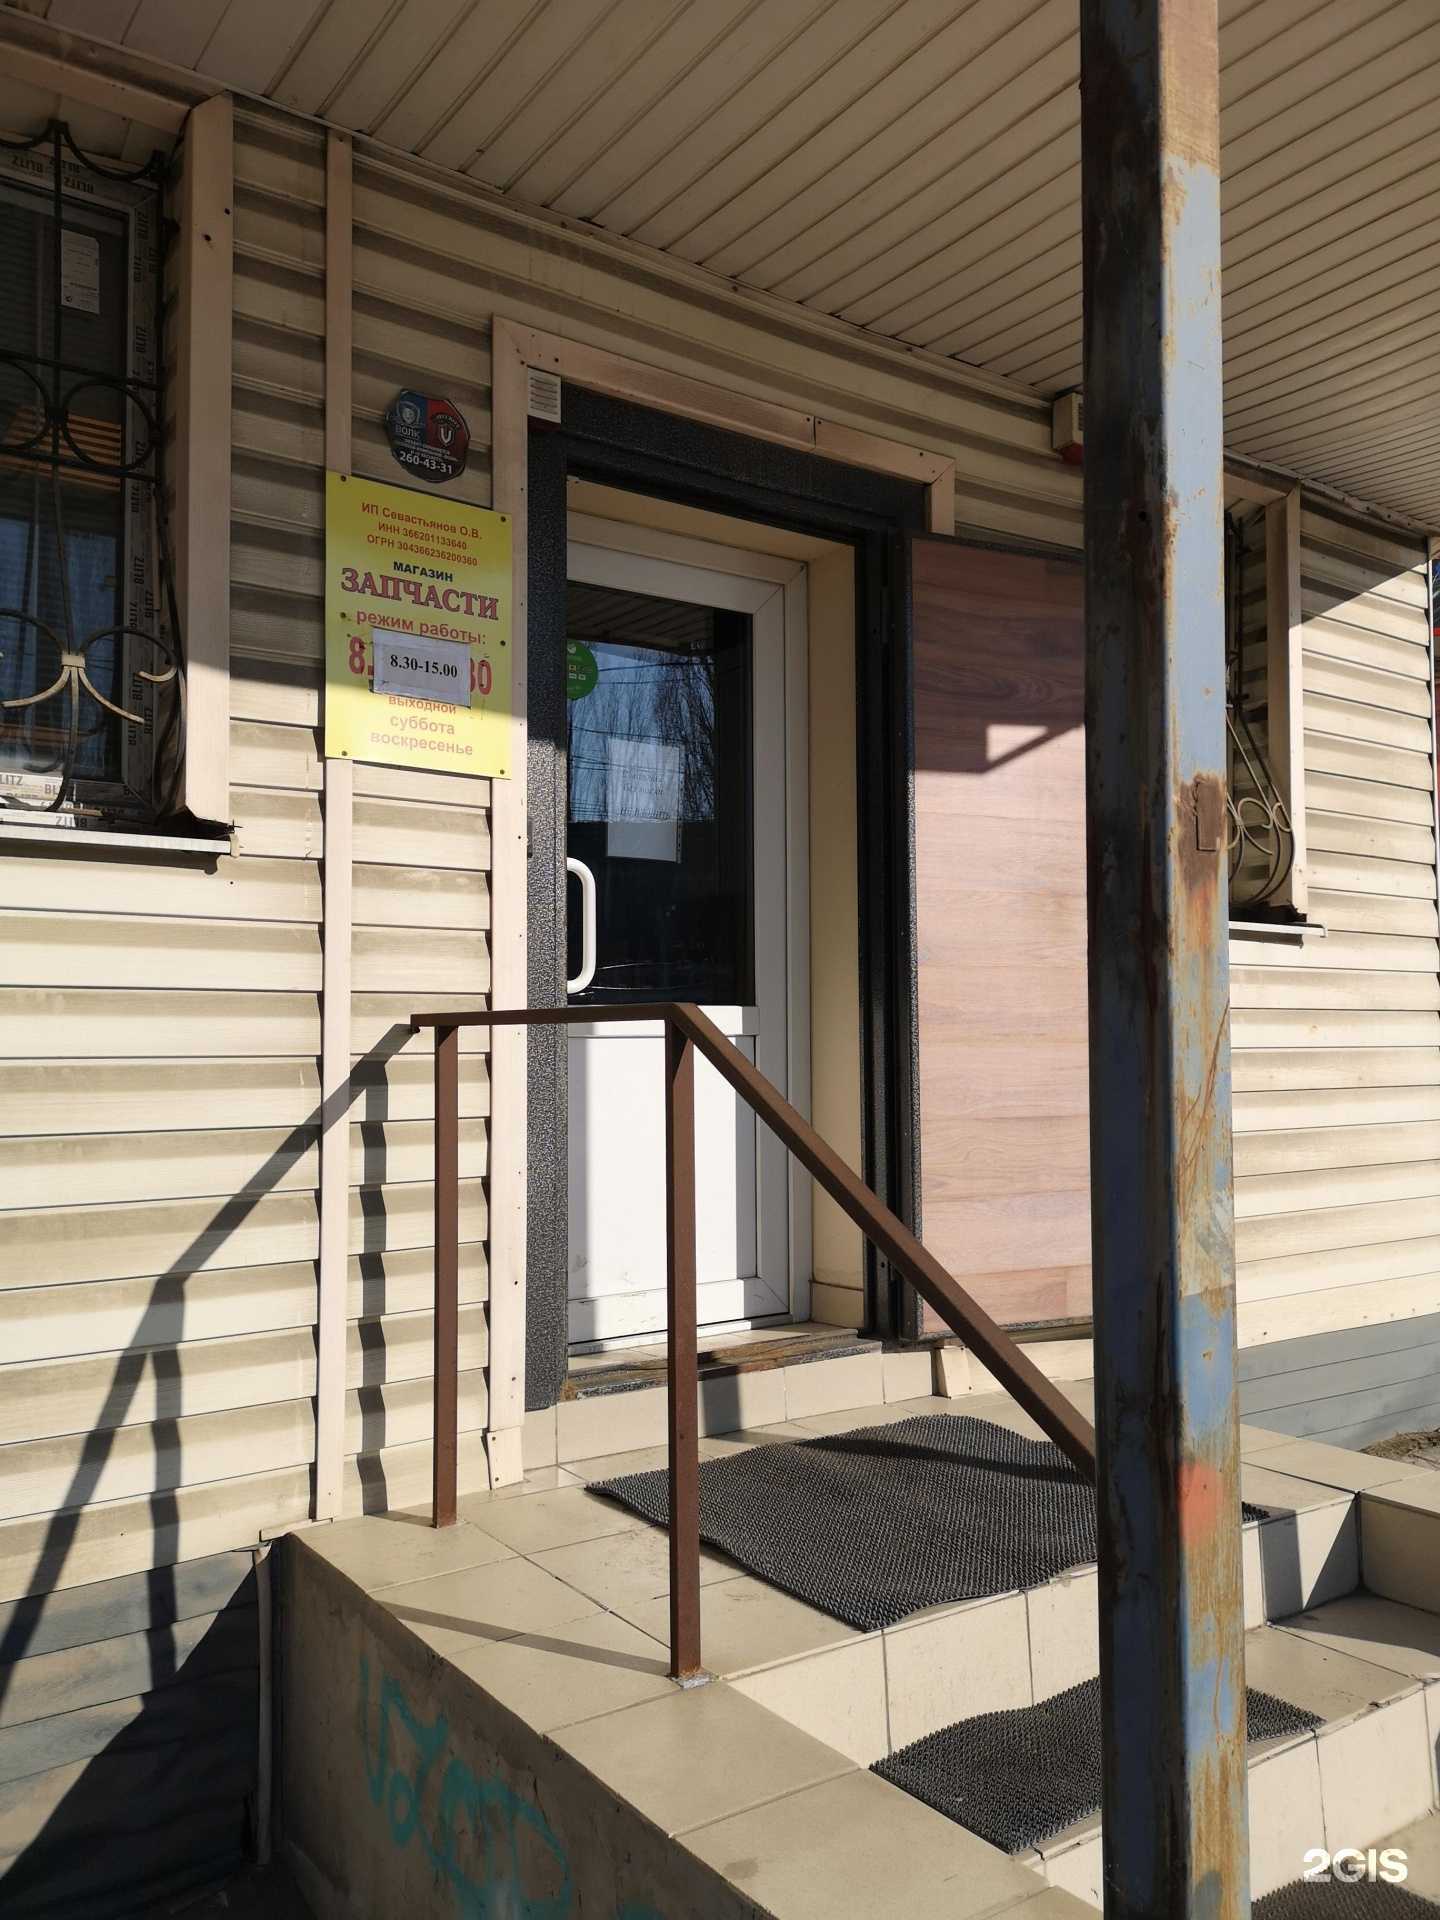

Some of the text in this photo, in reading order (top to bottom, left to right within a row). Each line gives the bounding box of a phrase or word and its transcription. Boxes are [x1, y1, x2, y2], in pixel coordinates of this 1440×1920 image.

[400, 450, 452, 474] 260-43-31
[362, 503, 482, 540] ИП Севастьянов О.В.
[367, 534, 395, 548] ОГРН
[378, 521, 467, 550] ИНН 366201133640
[393, 560, 454, 582] МАГАЗИН
[340, 567, 499, 620] ЗАПЧАСТИ
[356, 611, 414, 630] режим
[390, 654, 458, 678] 8.30-15.00
[388, 696, 457, 715] выходной
[390, 715, 455, 735] суббота
[370, 732, 473, 756] воскресенье
[0, 774, 24, 786] LITZ
